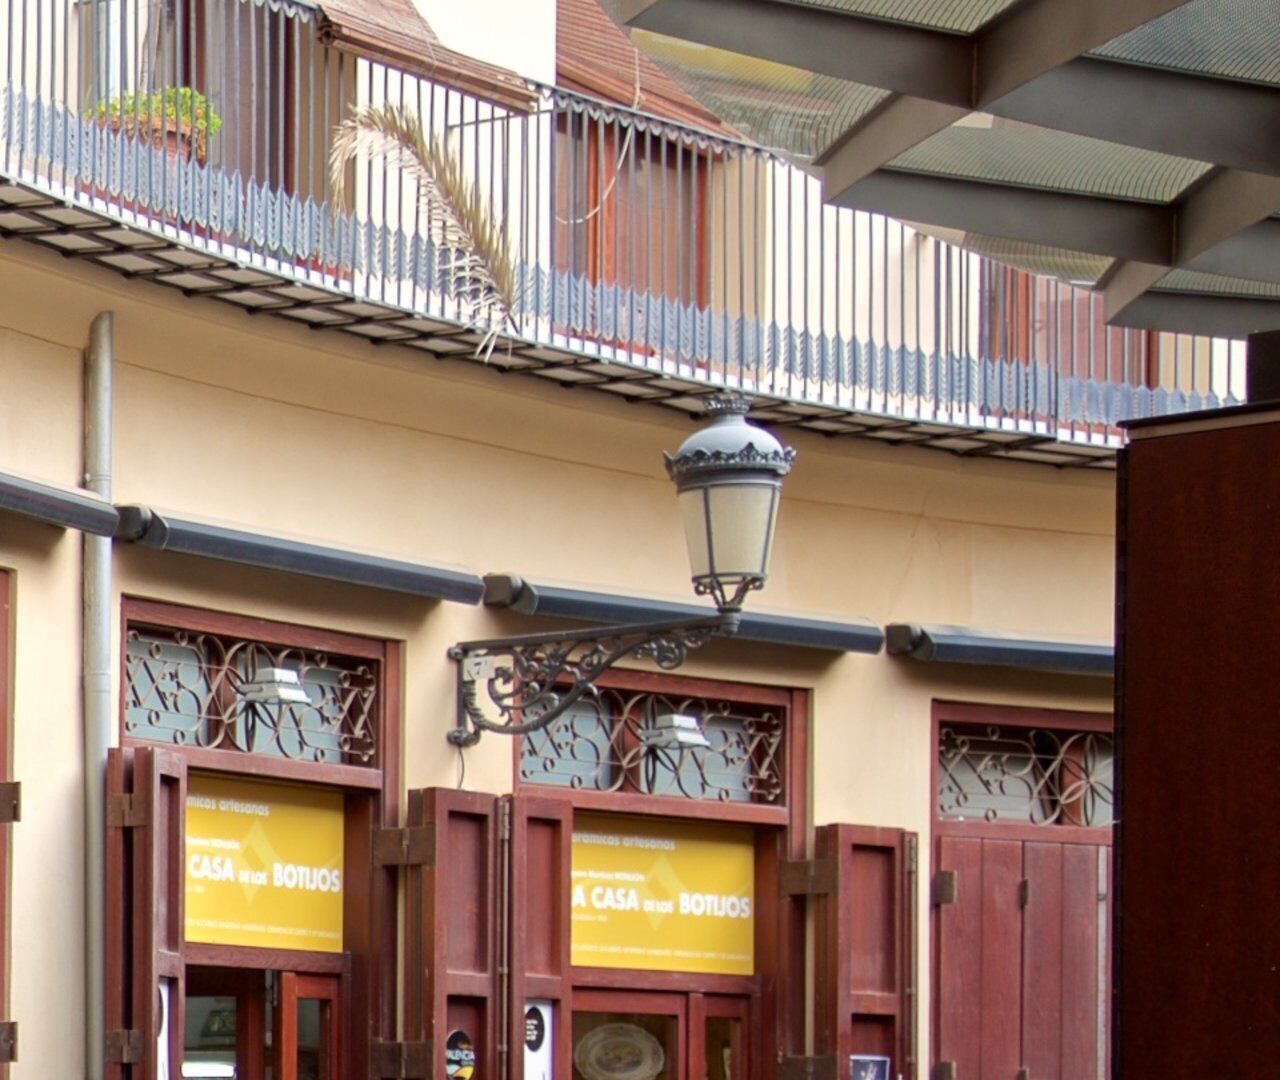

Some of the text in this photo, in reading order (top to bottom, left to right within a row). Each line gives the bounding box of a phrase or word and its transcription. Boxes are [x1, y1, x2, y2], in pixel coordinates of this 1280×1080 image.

[189, 854, 235, 883] CASA
[272, 862, 341, 894] BOTIJOS
[591, 885, 639, 911] CASA
[678, 891, 751, 919] BOTIJOS
